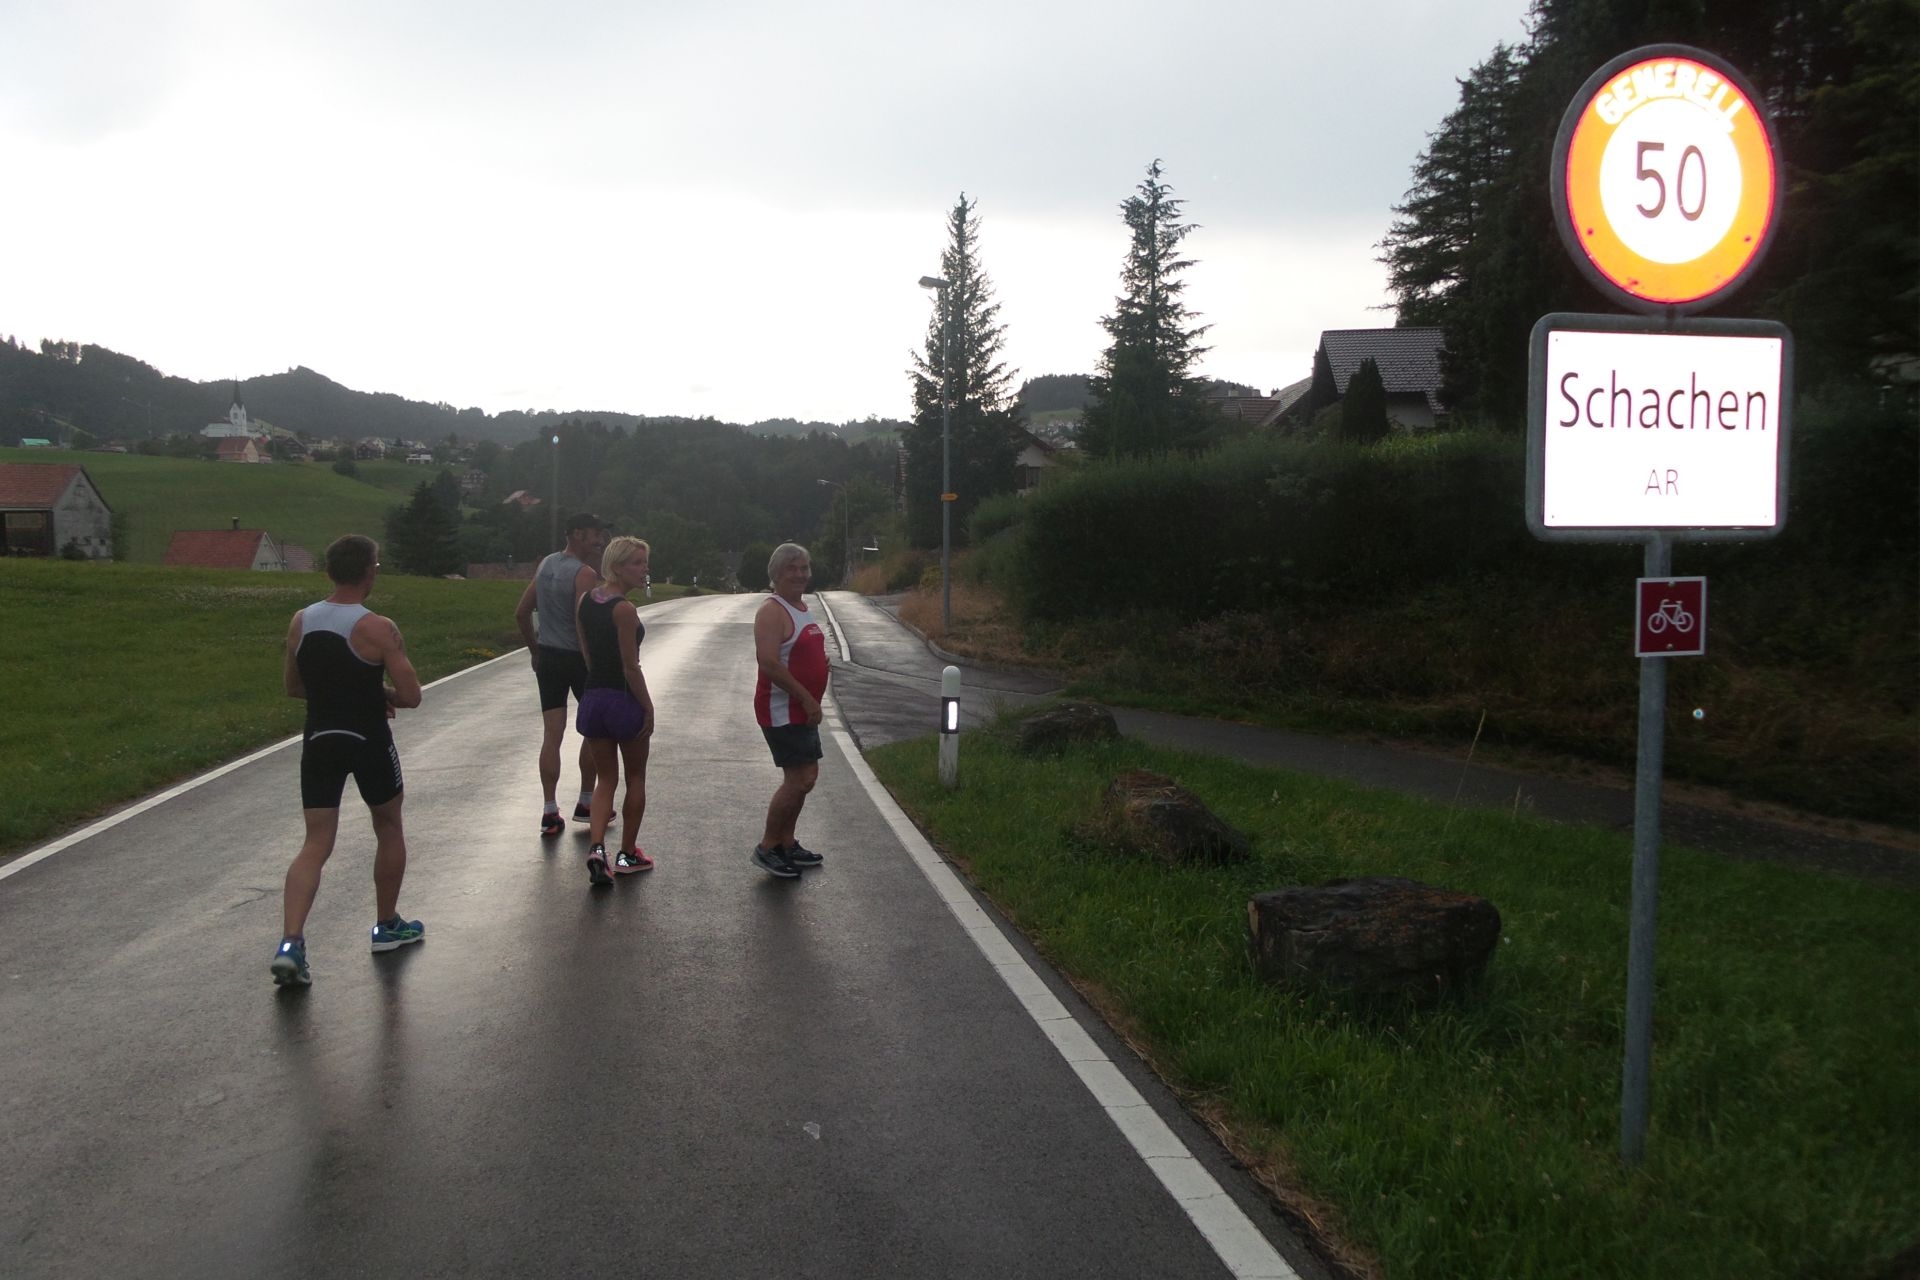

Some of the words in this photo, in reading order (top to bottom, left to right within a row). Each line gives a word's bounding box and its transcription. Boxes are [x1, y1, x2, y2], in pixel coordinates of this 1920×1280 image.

[1596, 63, 1744, 134] GENERELL
[1636, 141, 1707, 221] 50
[1559, 370, 1767, 430] Schachen
[1645, 469, 1679, 496] AR
